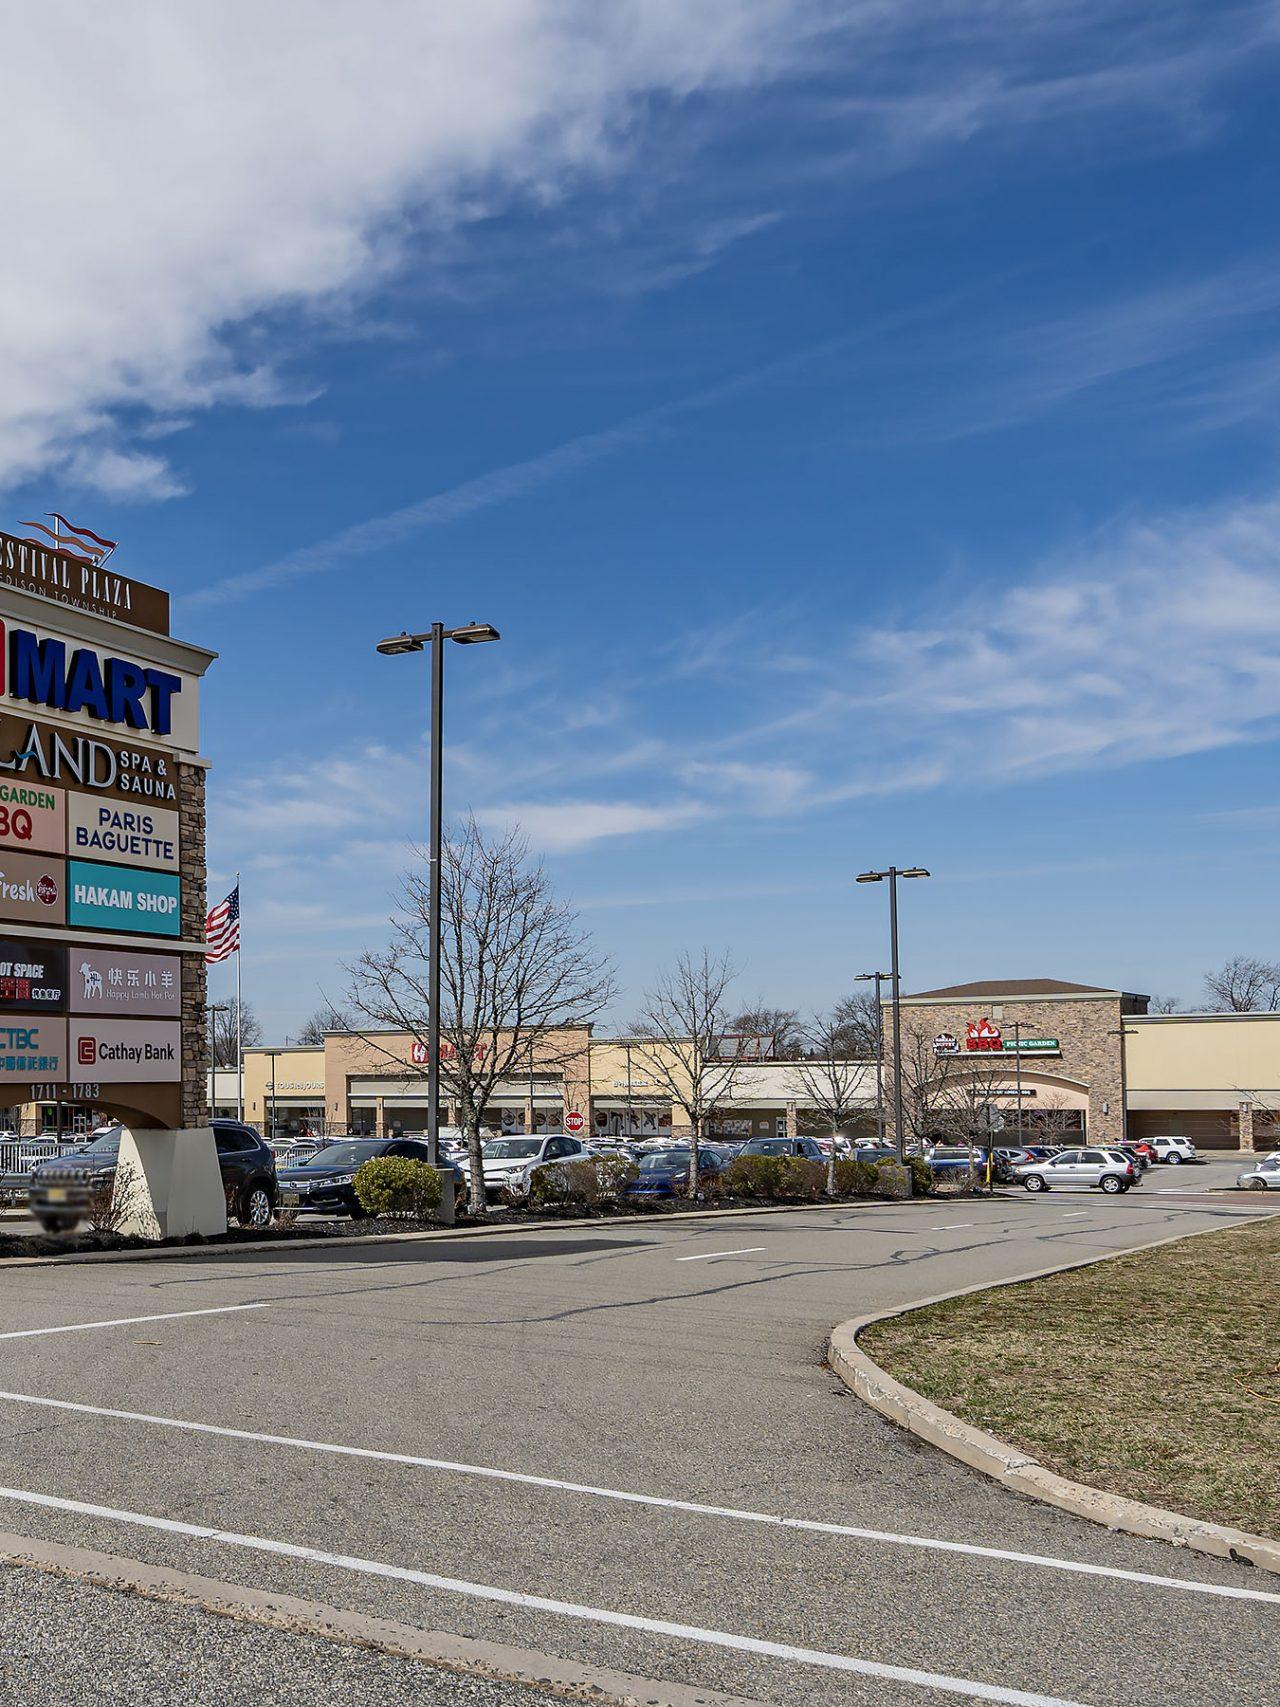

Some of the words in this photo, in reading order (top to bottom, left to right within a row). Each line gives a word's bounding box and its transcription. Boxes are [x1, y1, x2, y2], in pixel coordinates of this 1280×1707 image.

[81, 567, 131, 610] PLAZA
[55, 591, 117, 619] TOWNSHIP
[9, 629, 182, 735] MART
[120, 750, 151, 773] SPA
[157, 759, 168, 776] &
[0, 785, 56, 810] GARDEN
[120, 774, 176, 800] SAUNA
[99, 807, 154, 835] PARIS
[76, 827, 174, 860] BAGUETTE
[74, 884, 132, 910] HAKAM
[137, 893, 177, 914] SHOP
[14, 963, 44, 979] SPACE
[108, 967, 173, 988] 快乐小羊
[106, 989, 129, 1000] Happy
[131, 990, 148, 999] Lamb
[151, 991, 162, 1000] Hot
[99, 1043, 143, 1064] Cathay
[145, 1043, 175, 1061] Bank
[967, 1038, 1003, 1051] BBQ
[31, 1084, 57, 1100] 1711
[72, 1083, 100, 1099] 1783
[567, 1117, 583, 1126] STOP
